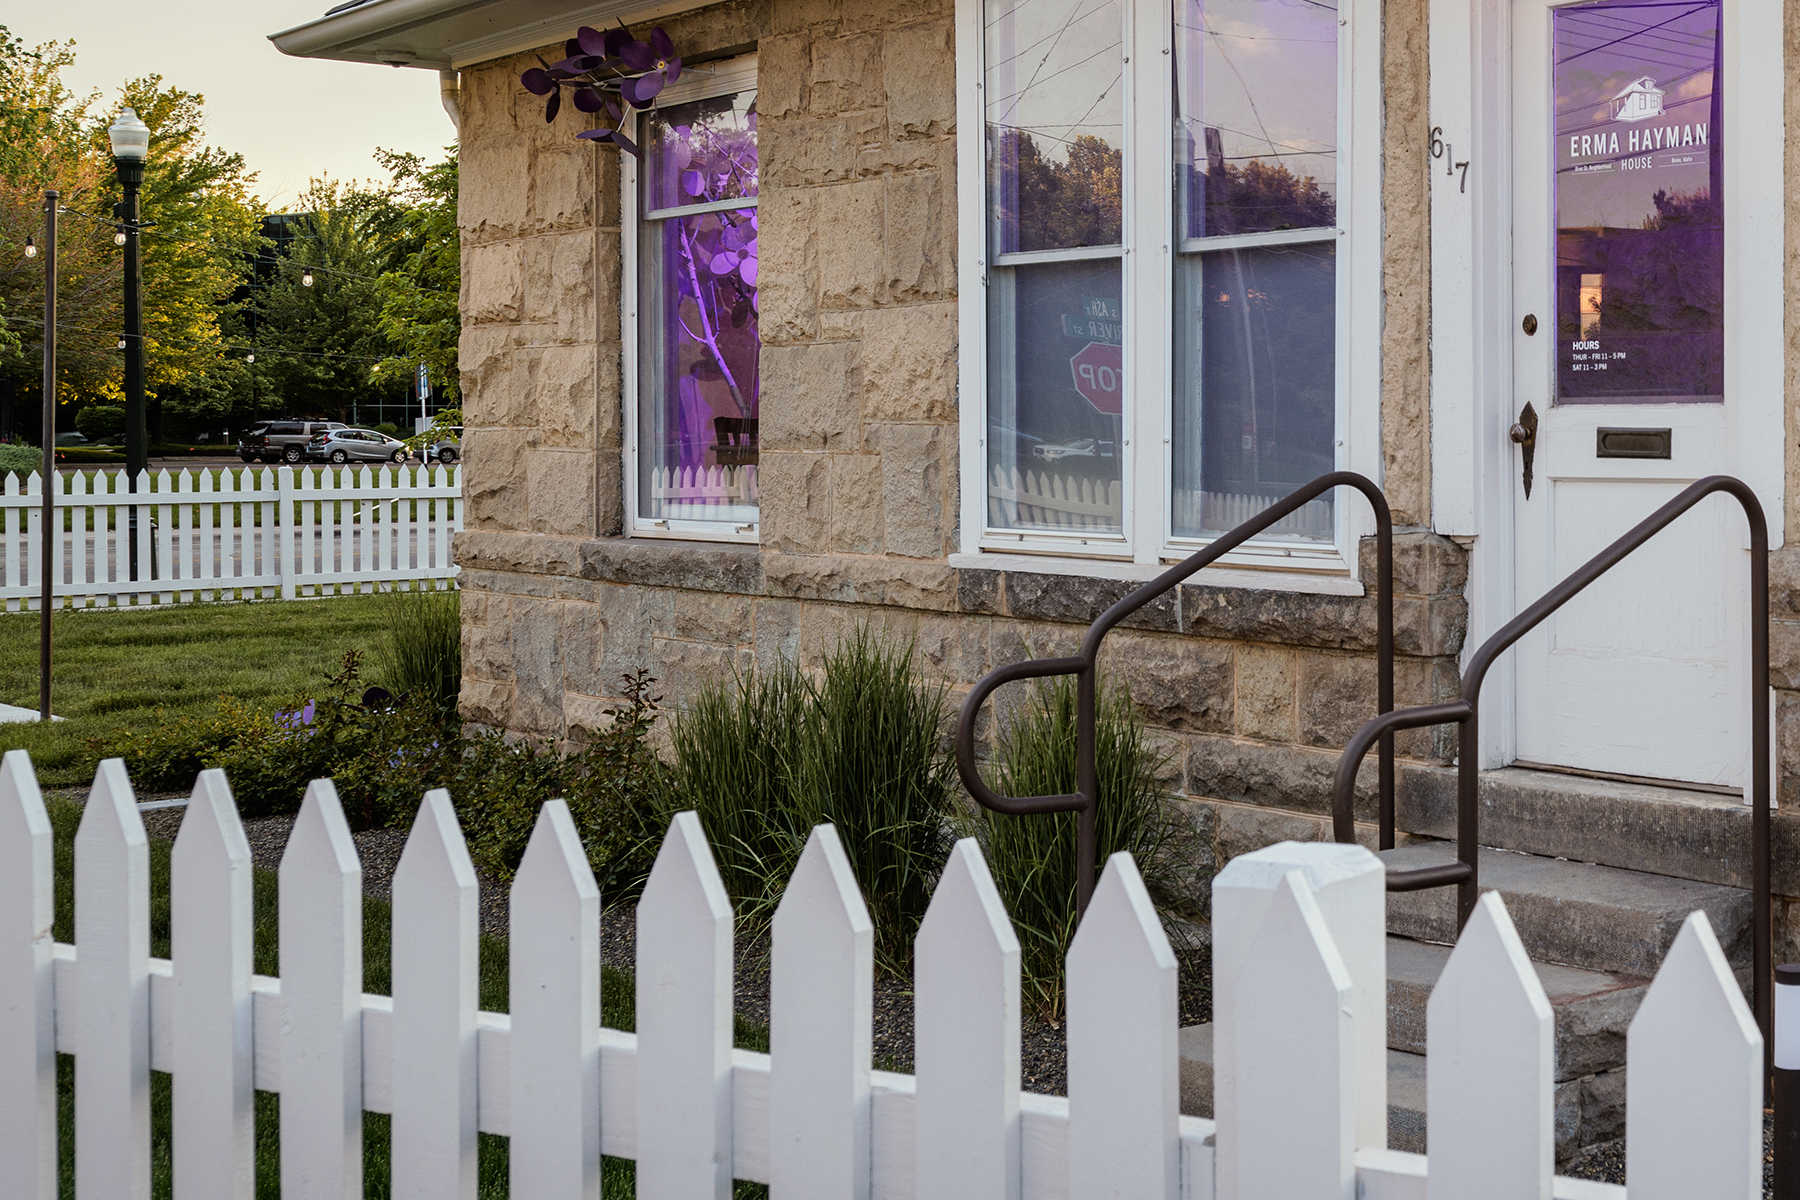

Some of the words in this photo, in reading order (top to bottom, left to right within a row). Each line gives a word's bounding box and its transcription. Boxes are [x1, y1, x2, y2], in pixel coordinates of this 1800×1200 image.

[1570, 132, 1619, 157] ERMA
[1629, 123, 1706, 151] HAYMAN
[1431, 126, 1470, 194] 617
[1621, 157, 1652, 170] HOUSE
[1572, 340, 1600, 350] HOURS
